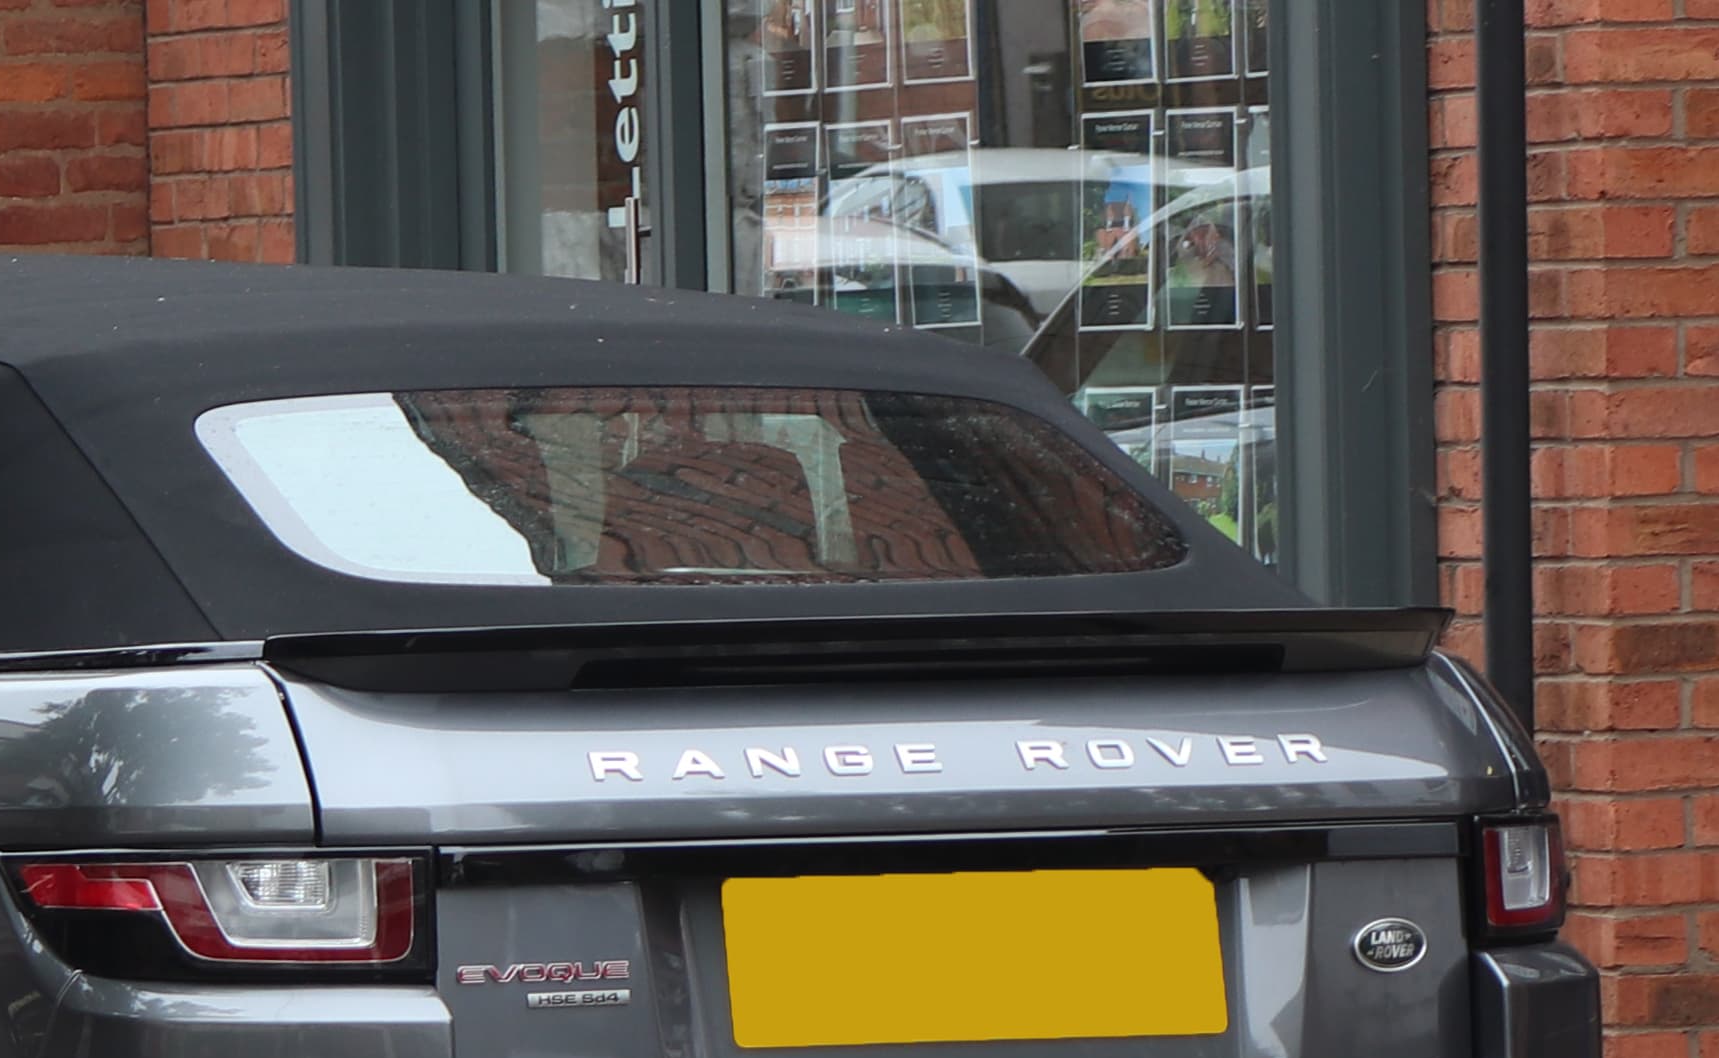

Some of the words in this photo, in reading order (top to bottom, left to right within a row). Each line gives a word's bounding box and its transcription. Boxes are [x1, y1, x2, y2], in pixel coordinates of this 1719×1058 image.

[587, 743, 943, 783] RANGE
[1015, 733, 1328, 771] ROVER
[1370, 930, 1404, 946] LAND
[1373, 943, 1415, 960] ROVER
[456, 960, 629, 985] EVOQUE
[537, 995, 578, 1006] HSE
[582, 992, 620, 1004] Sd4
